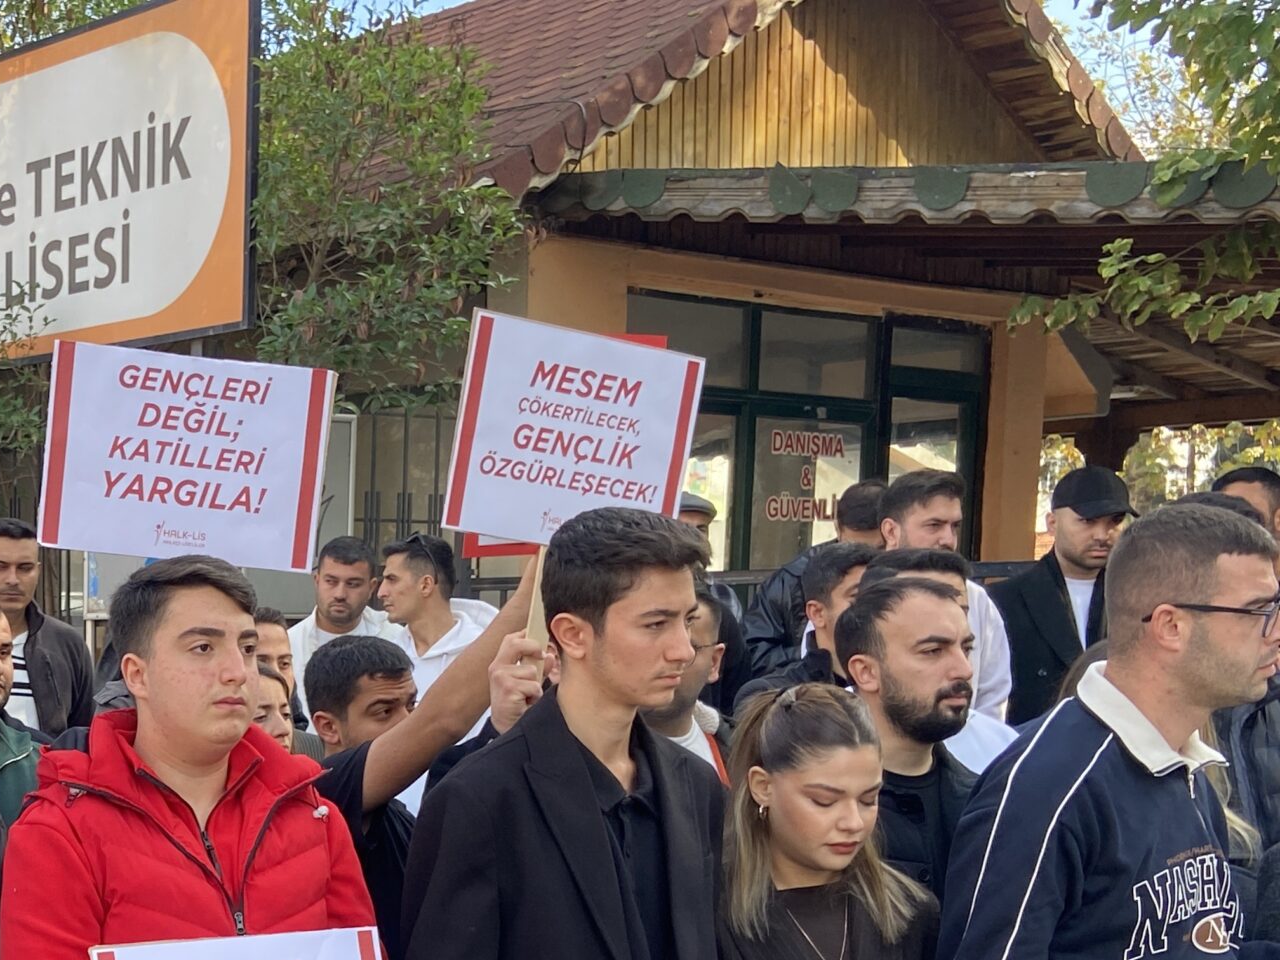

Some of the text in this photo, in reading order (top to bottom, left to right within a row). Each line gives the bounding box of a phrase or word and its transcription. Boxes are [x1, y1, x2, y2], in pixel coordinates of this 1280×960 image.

[26, 111, 192, 218] TEKNİK
[6, 208, 130, 309] LİSESİ
[118, 364, 272, 405] GENÇLERİ
[530, 361, 642, 407] MESEM
[137, 401, 243, 443] DEĞİL;
[518, 395, 640, 437] ÇÖKERTİLECEK,
[108, 437, 267, 475] KATİLLERİ
[513, 423, 640, 470] GENÇLİK
[772, 430, 844, 461] DANIŞMA
[103, 470, 267, 514] YARGILA!
[479, 451, 657, 504] ÖZGÜRLEŞECEK!
[801, 466, 812, 488] &
[766, 492, 837, 521] GÜVENLİ
